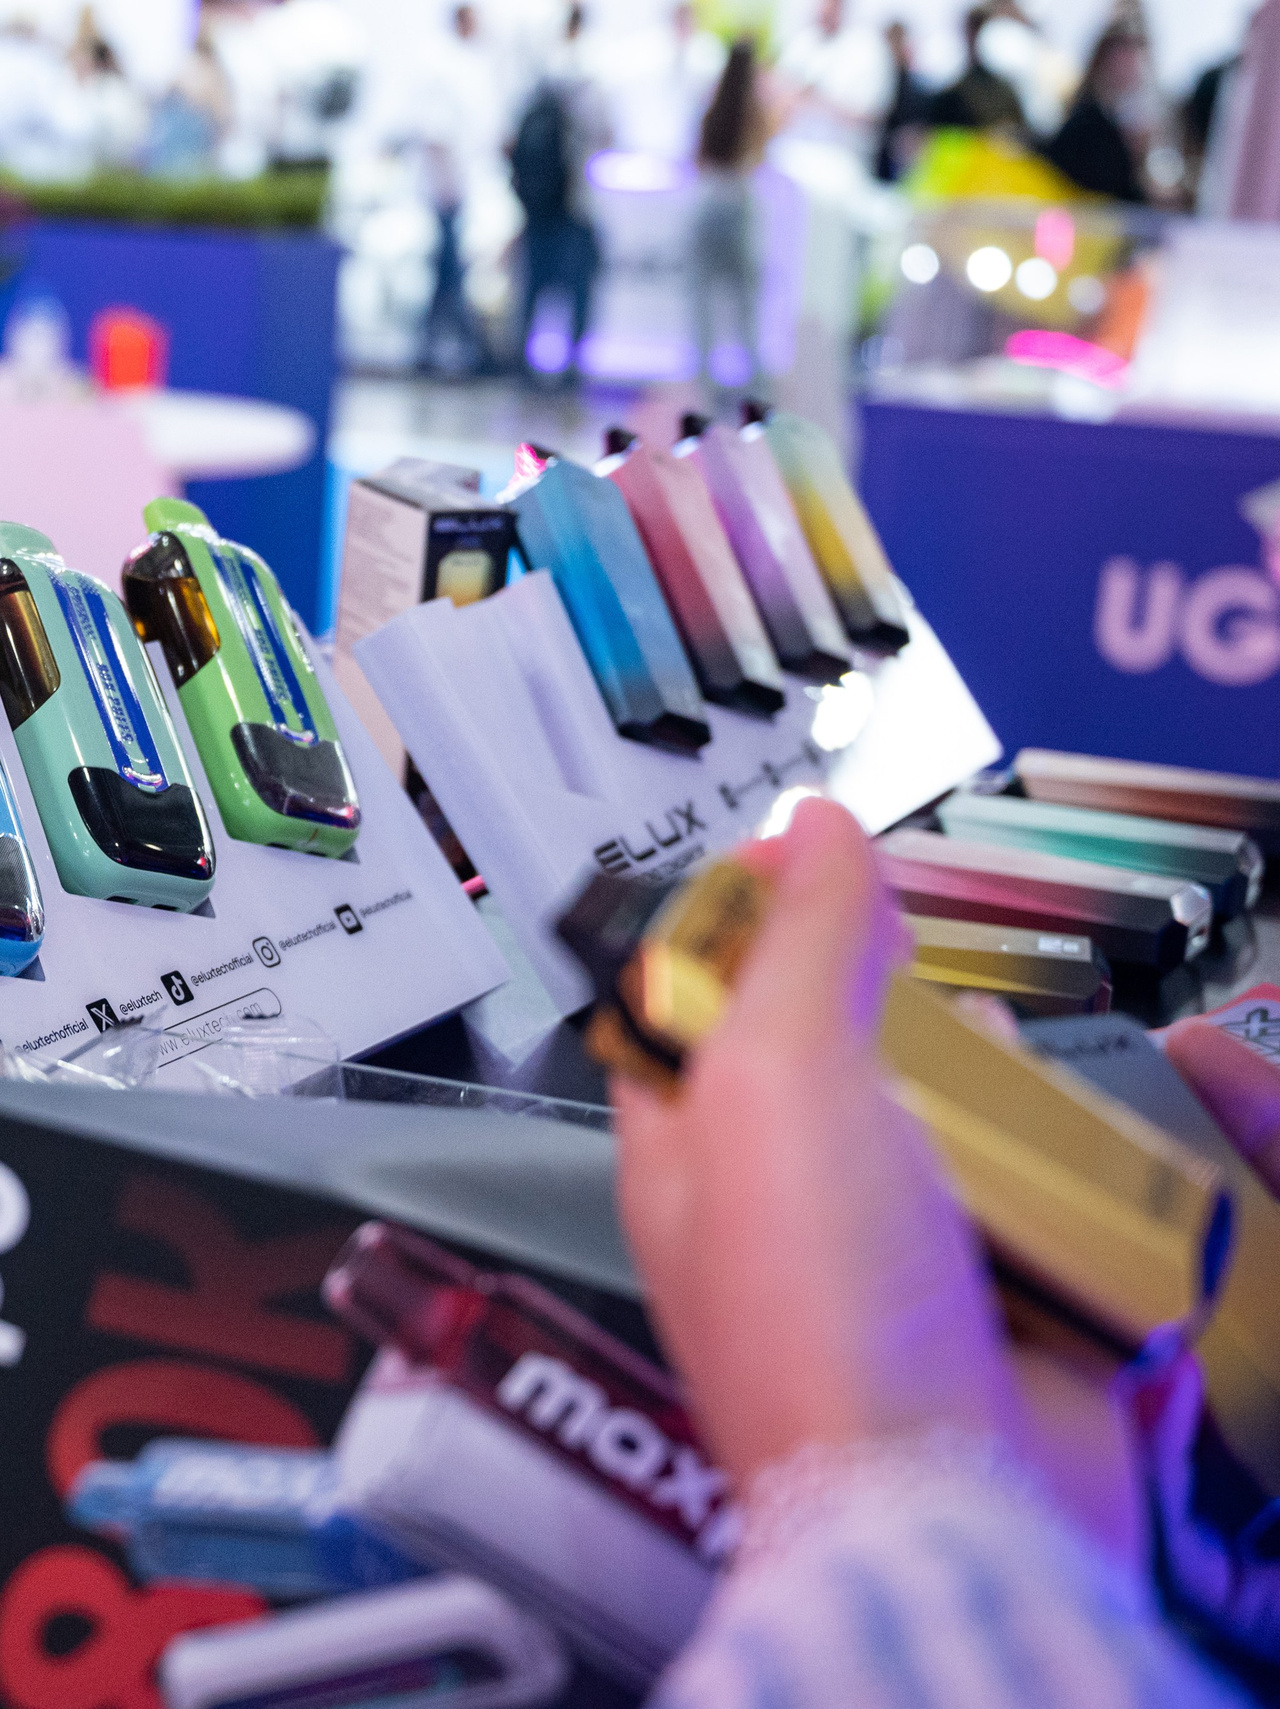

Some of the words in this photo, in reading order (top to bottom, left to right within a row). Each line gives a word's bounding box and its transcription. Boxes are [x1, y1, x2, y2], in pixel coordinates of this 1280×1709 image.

[593, 799, 706, 876] ELUX
[119, 989, 163, 1016] @eluxtech
[190, 952, 255, 987] @eluxtechofficial
[496, 1351, 746, 1556] max
